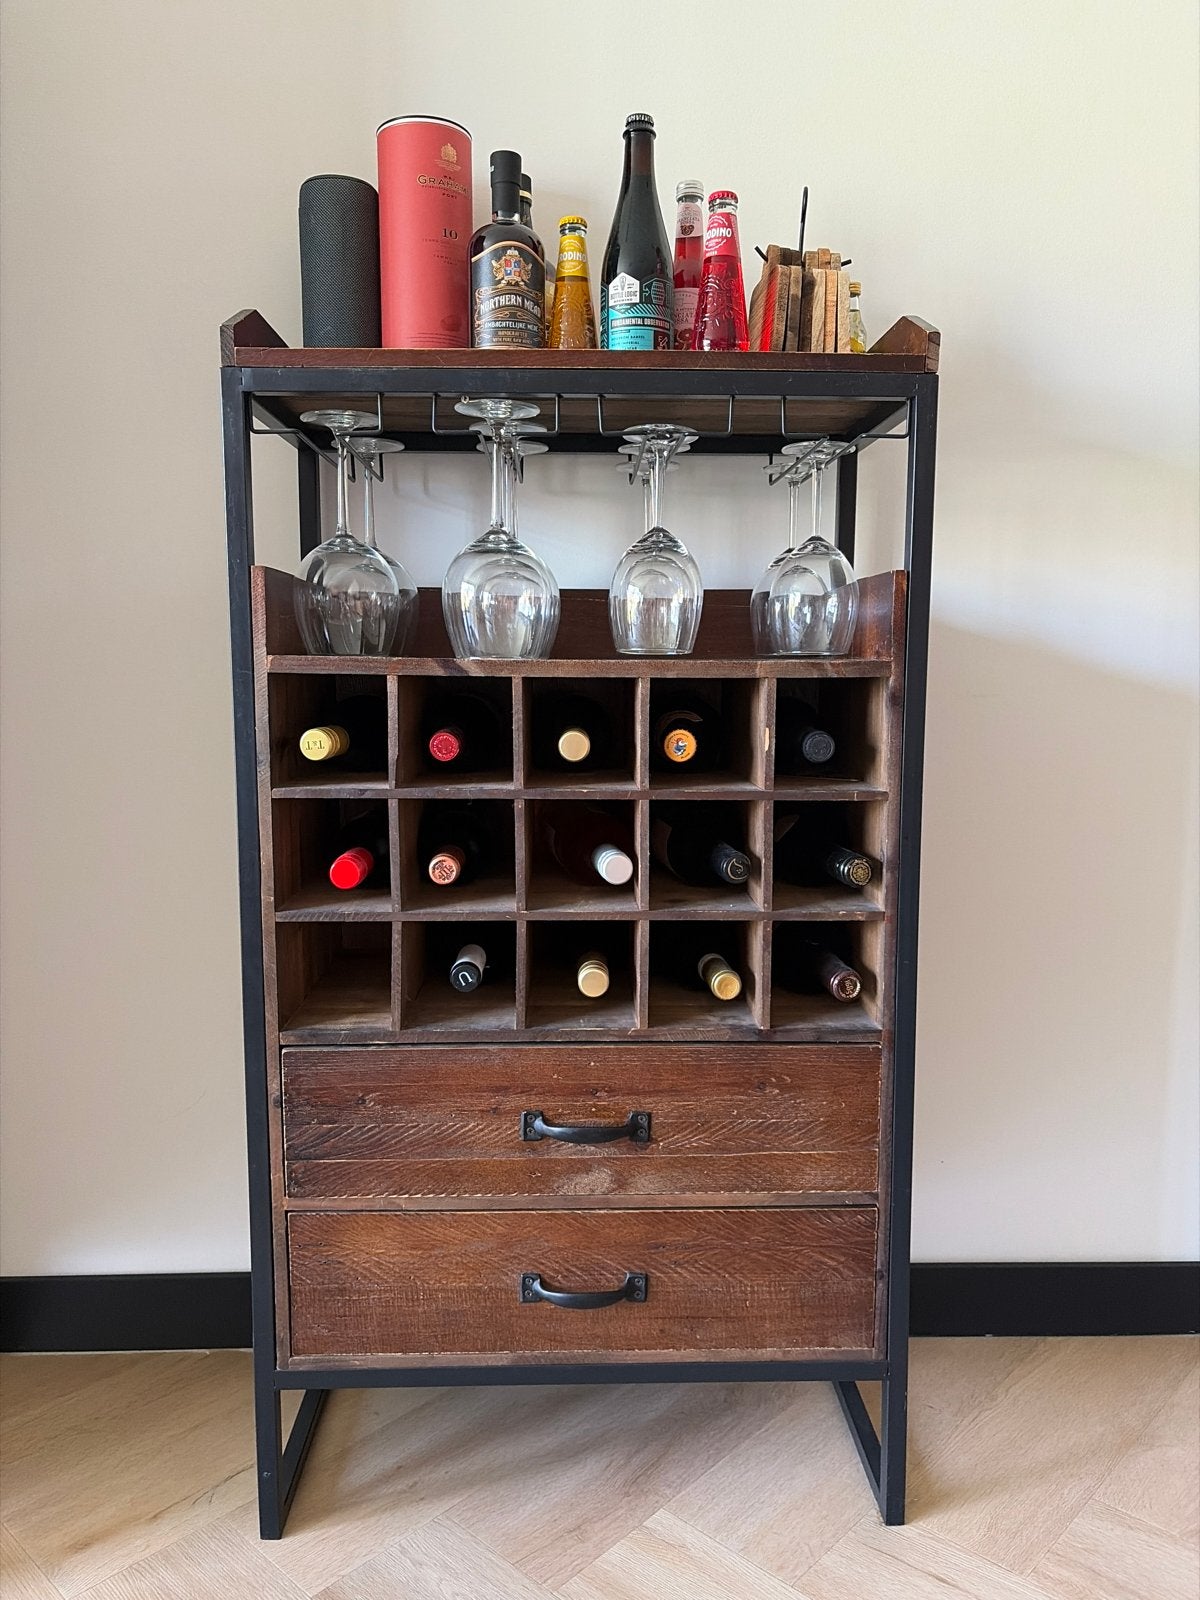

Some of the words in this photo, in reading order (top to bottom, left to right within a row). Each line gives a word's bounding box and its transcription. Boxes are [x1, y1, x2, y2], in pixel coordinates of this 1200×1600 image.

[442, 228, 458, 240] 10
[480, 294, 522, 315] NORTHERN
[611, 317, 643, 328] FUNDAMENTAL
